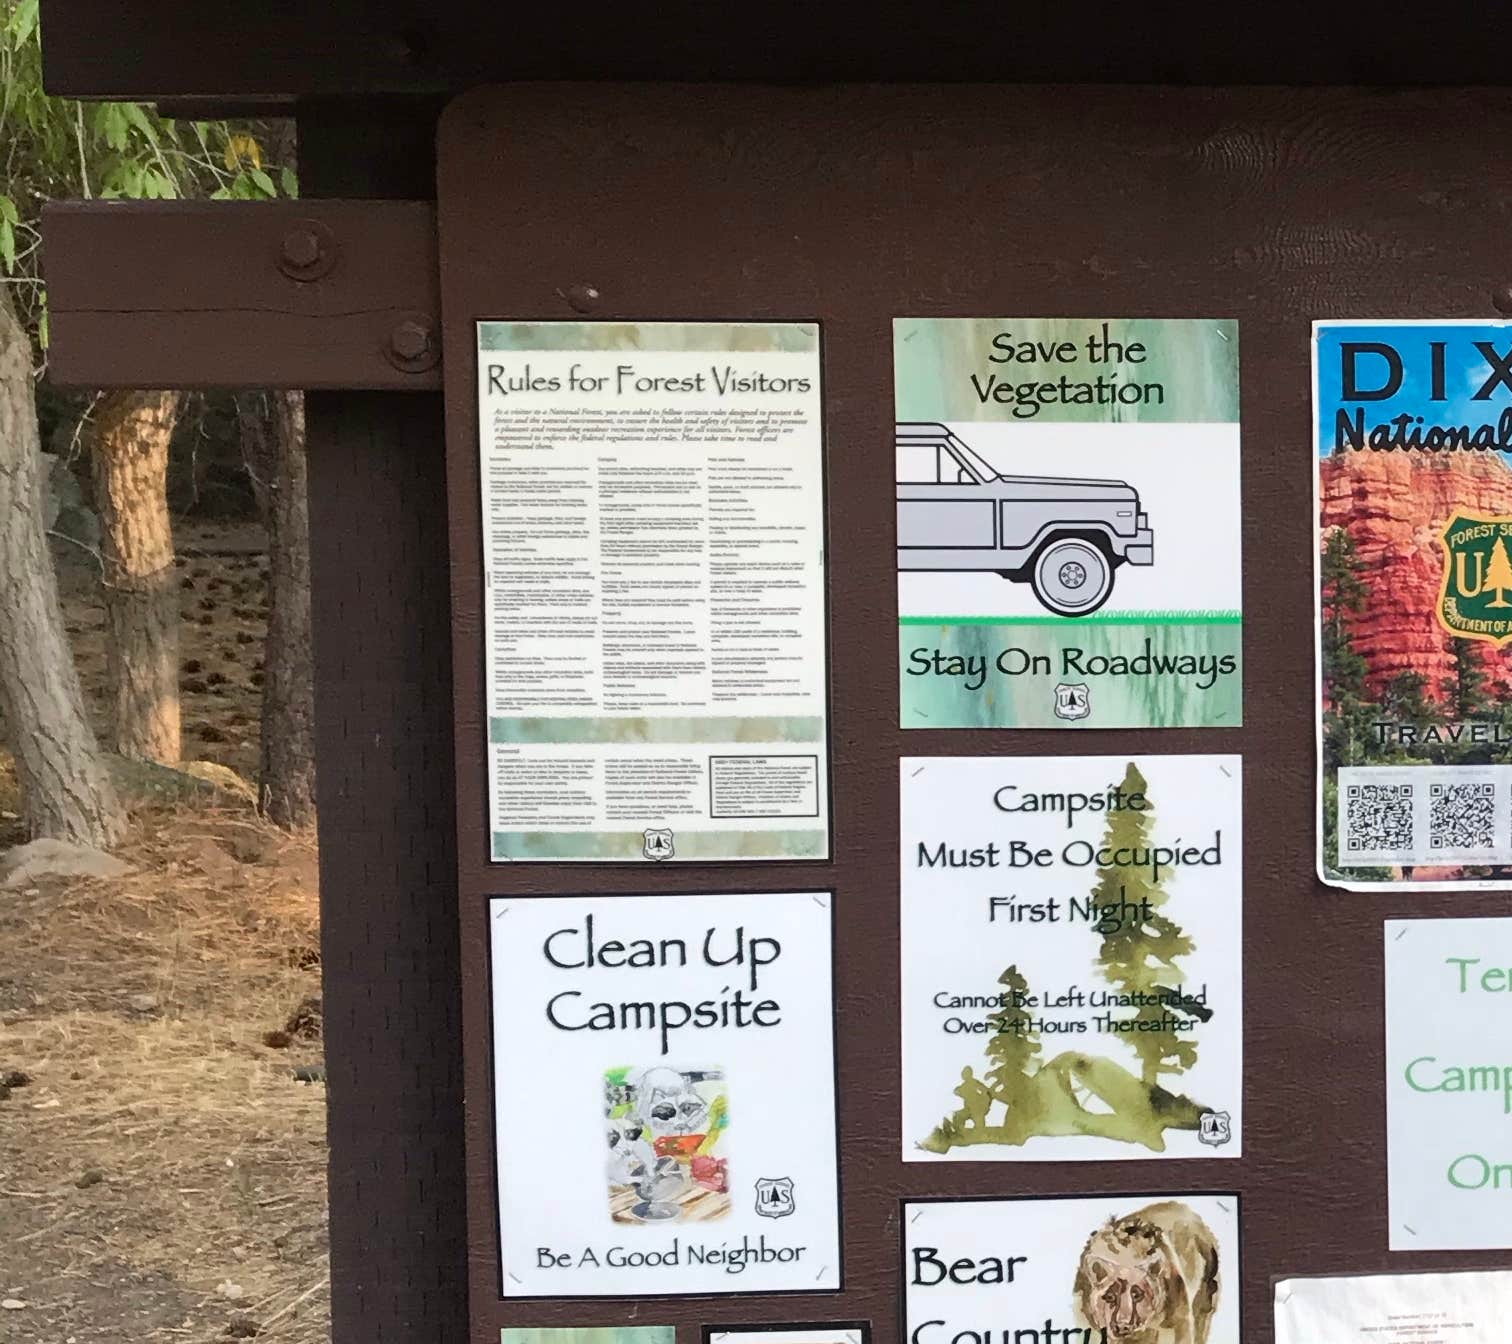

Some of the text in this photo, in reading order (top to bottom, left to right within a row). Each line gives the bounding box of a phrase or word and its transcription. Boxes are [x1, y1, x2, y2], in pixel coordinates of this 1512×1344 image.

[988, 323, 1146, 364] Save the
[488, 364, 811, 395] Rules for Forest Visitors
[970, 372, 1164, 418] Vegetation
[1451, 525, 1496, 548] FOREST
[1444, 597, 1492, 632] DEPARTMENT
[1494, 621, 1506, 632] OF
[906, 638, 1236, 690] Stay On Roadways
[993, 783, 1145, 828] Campsite
[917, 830, 1221, 882] Must Be Occupied
[989, 886, 1153, 934] First Night
[543, 914, 781, 991] Clean Up
[933, 985, 1206, 1009] Cannot Be Left Unattended
[546, 986, 781, 1055] Campsite
[944, 1013, 1198, 1034] Over 24 Hours Thereafter
[537, 1236, 806, 1274] Be A Good Neighbor
[912, 1247, 1027, 1286] Bear
